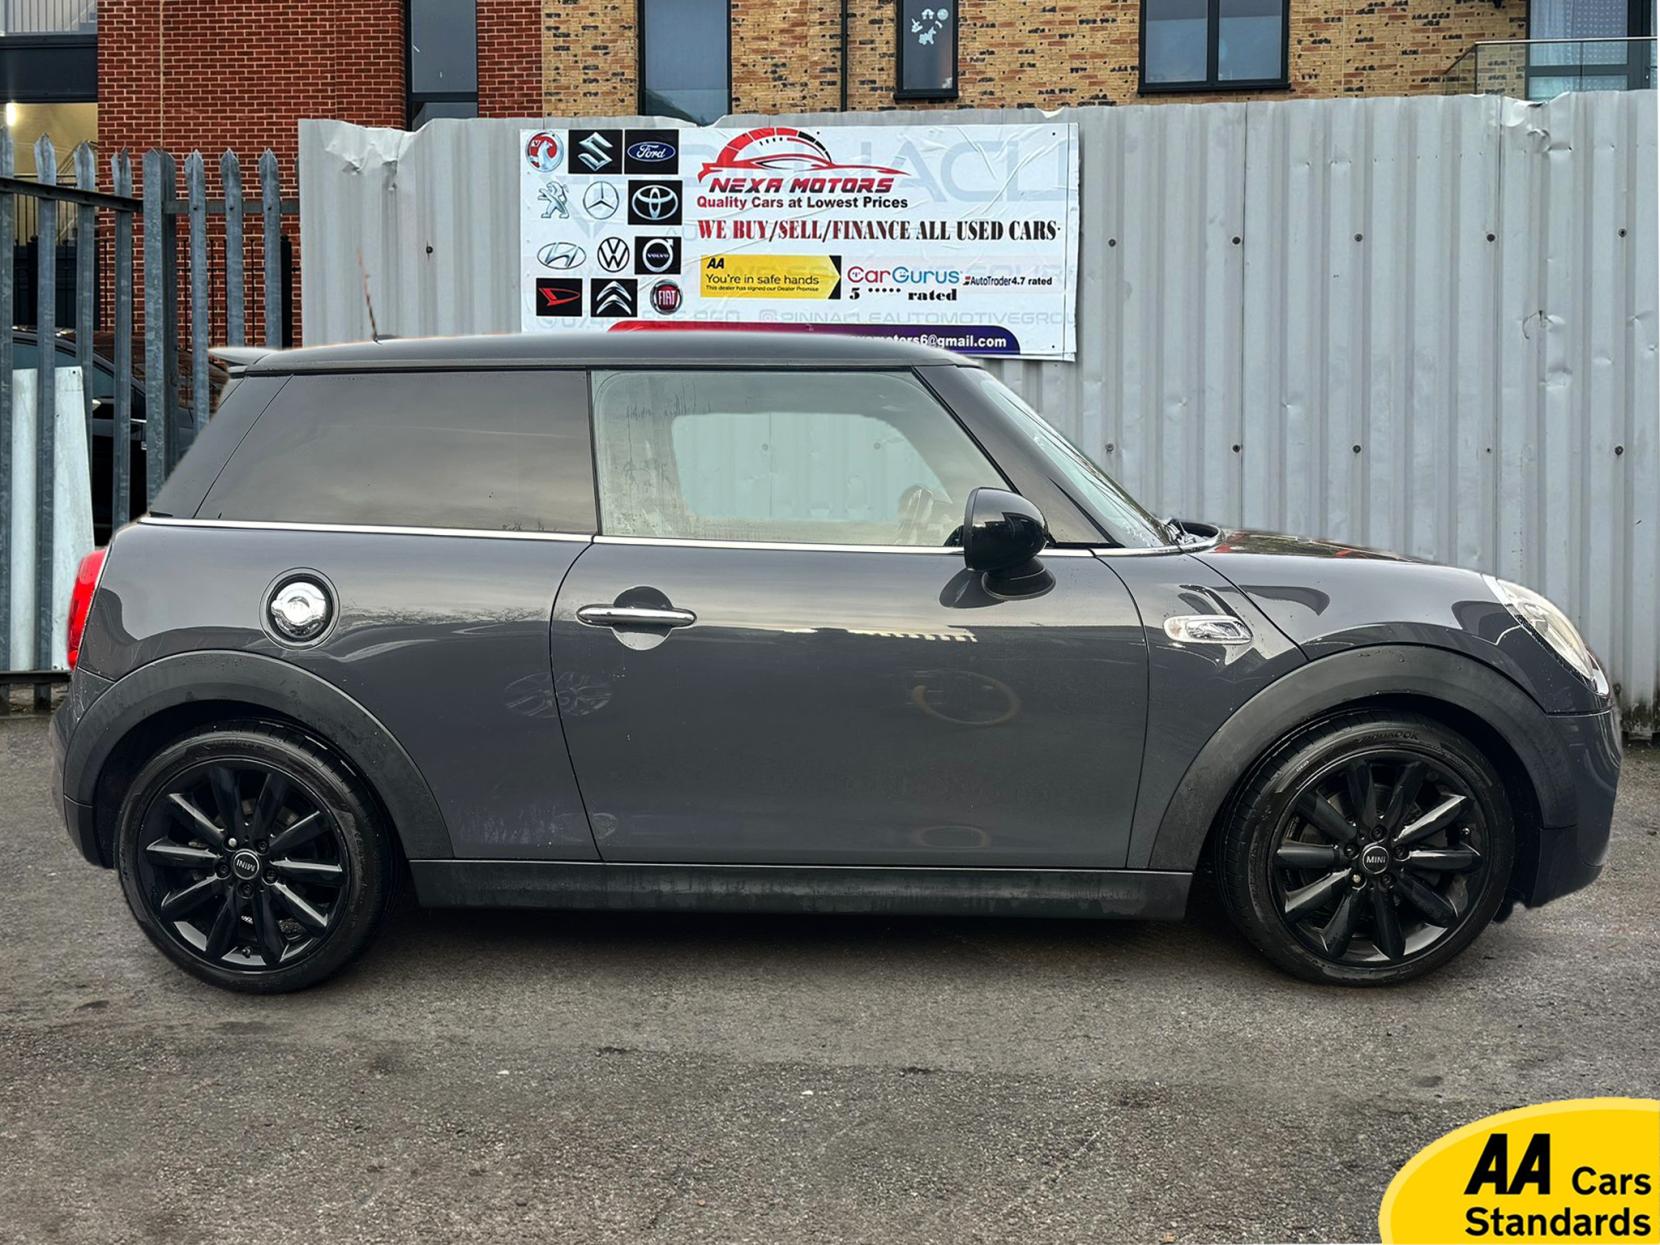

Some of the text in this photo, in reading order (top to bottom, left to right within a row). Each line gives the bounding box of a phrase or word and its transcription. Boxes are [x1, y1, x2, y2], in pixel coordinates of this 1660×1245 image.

[636, 144, 666, 159] Ford
[709, 178, 894, 193] NEXA MOTORS
[697, 196, 908, 210] Quality Cars at Lowest Prices
[697, 220, 726, 239] WE
[916, 220, 951, 240] ALL
[956, 220, 1004, 241] USED
[706, 257, 725, 269] AA
[706, 274, 820, 285] You're in safe hands
[847, 266, 960, 284] CarGurus
[1028, 277, 1053, 286] rated
[658, 290, 676, 306] FIAT
[849, 287, 957, 301] 5 rated
[236, 859, 255, 872] MINI
[1366, 855, 1386, 864] MINI
